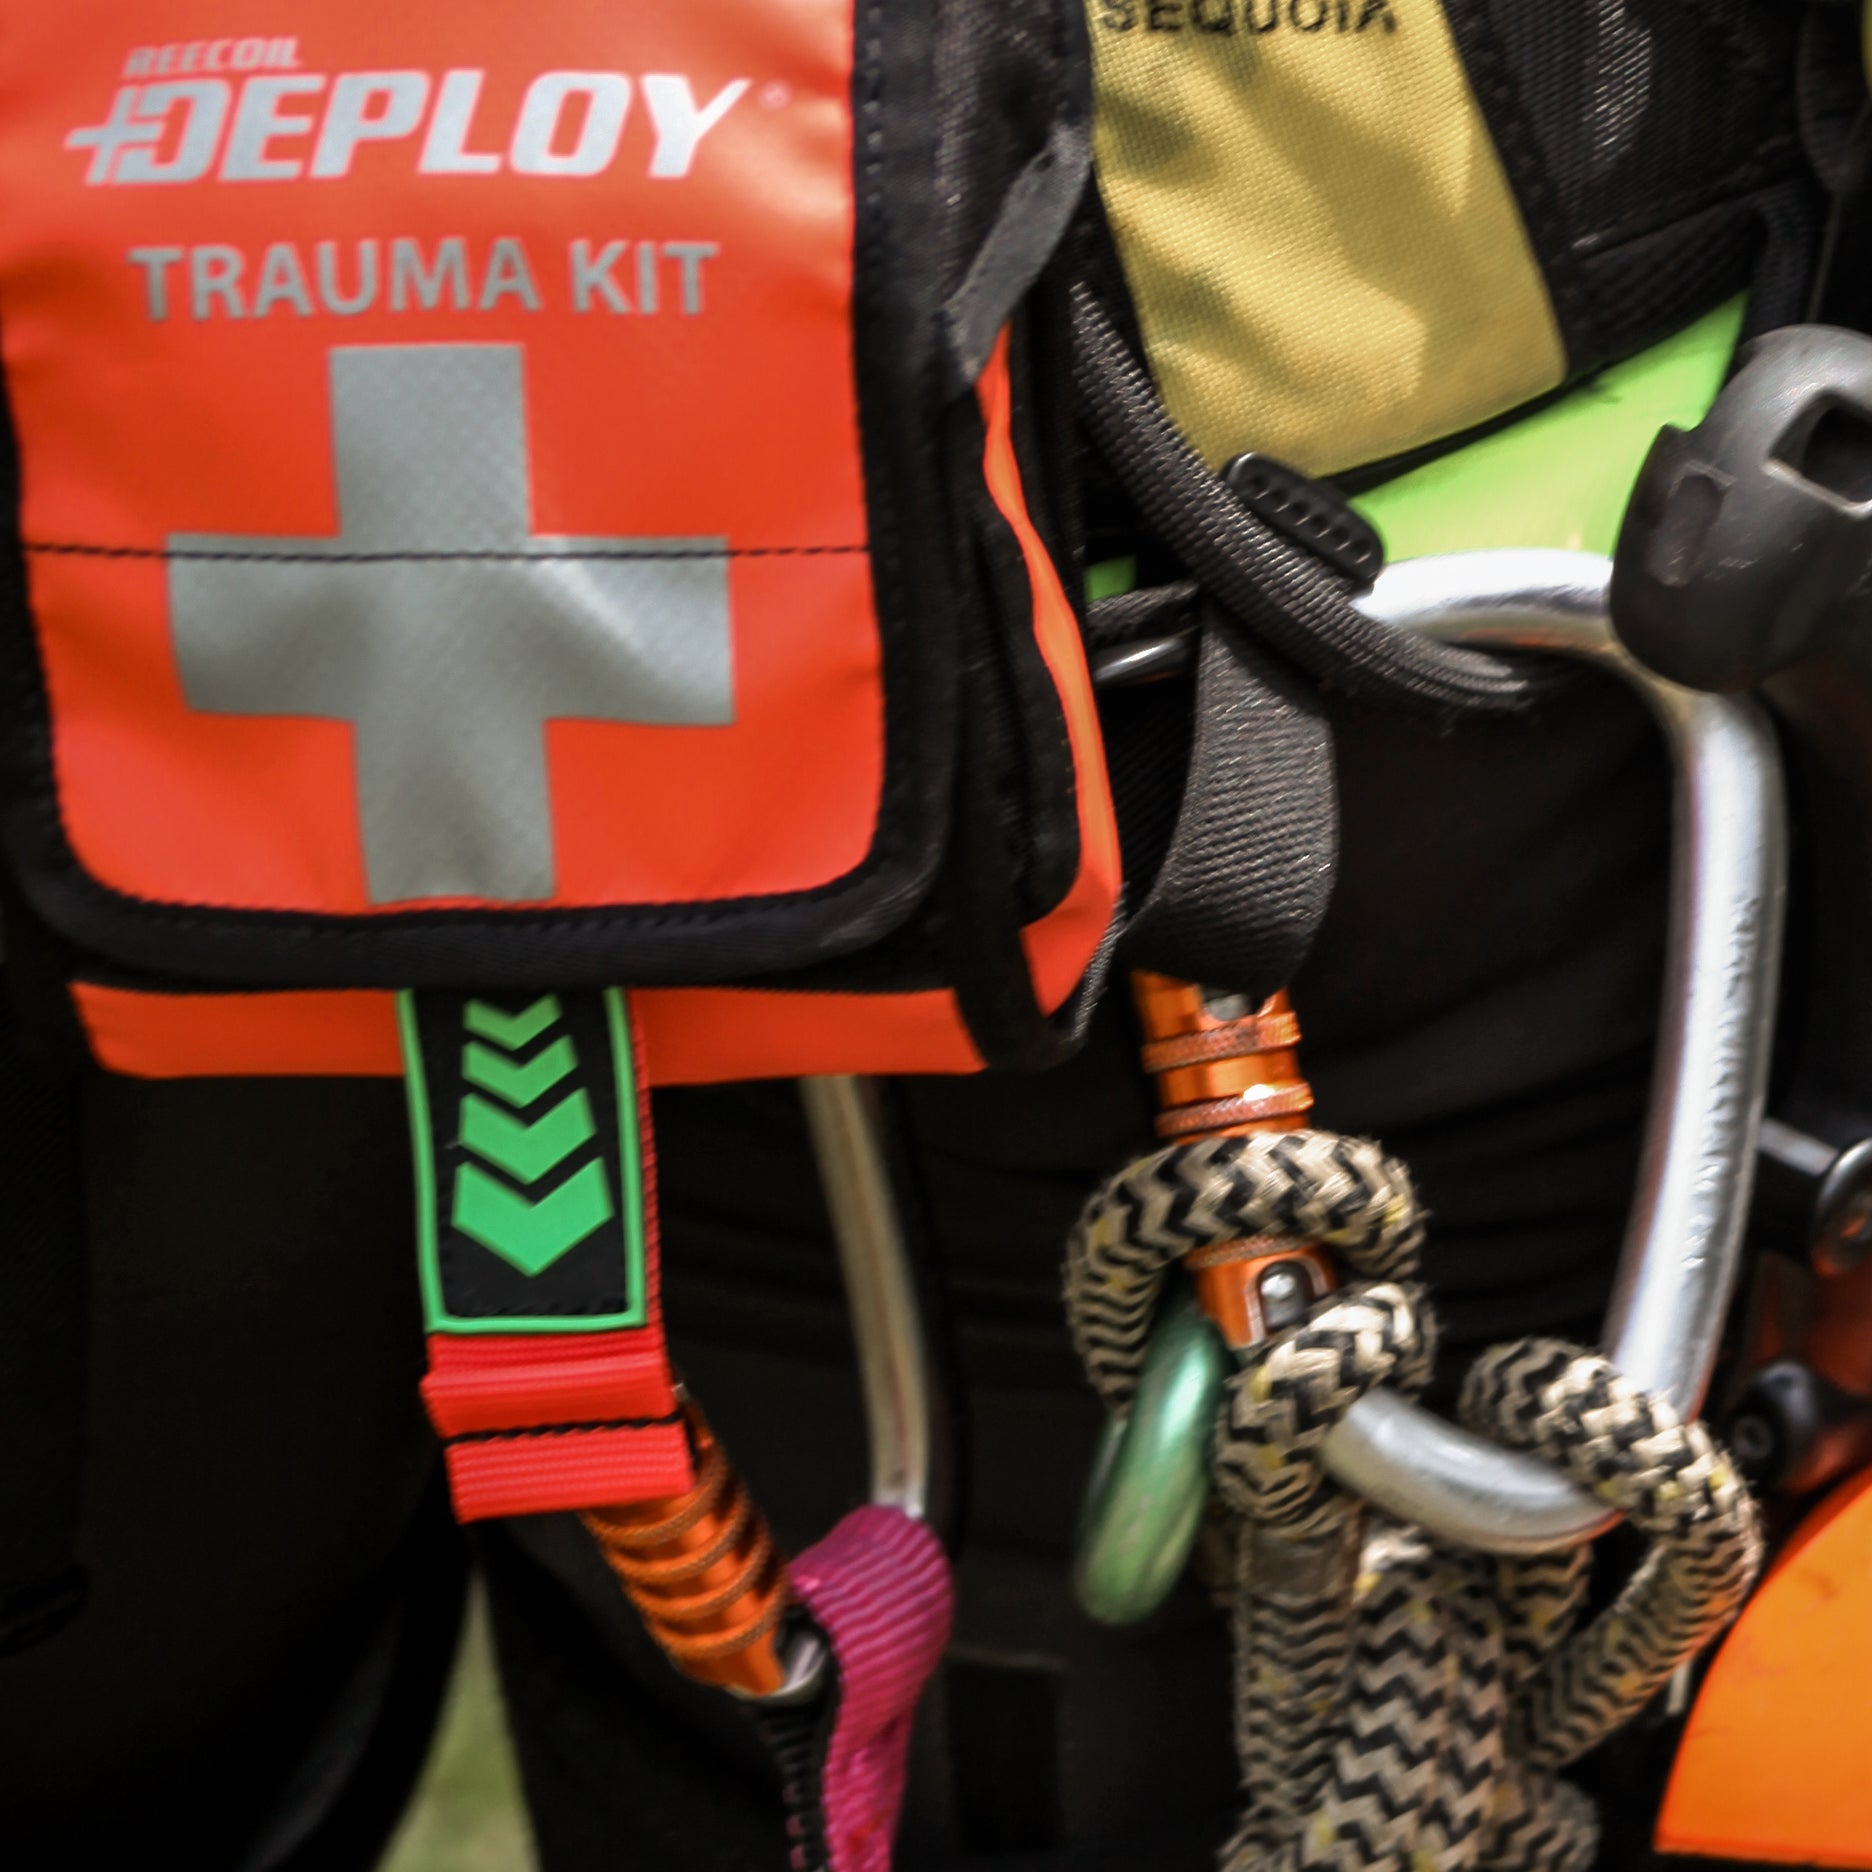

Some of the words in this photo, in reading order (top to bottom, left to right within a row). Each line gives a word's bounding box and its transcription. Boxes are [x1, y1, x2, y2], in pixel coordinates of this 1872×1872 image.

[64, 69, 753, 185] DEPLOY
[128, 236, 543, 322] TRAUMA
[569, 239, 720, 316] KIT
